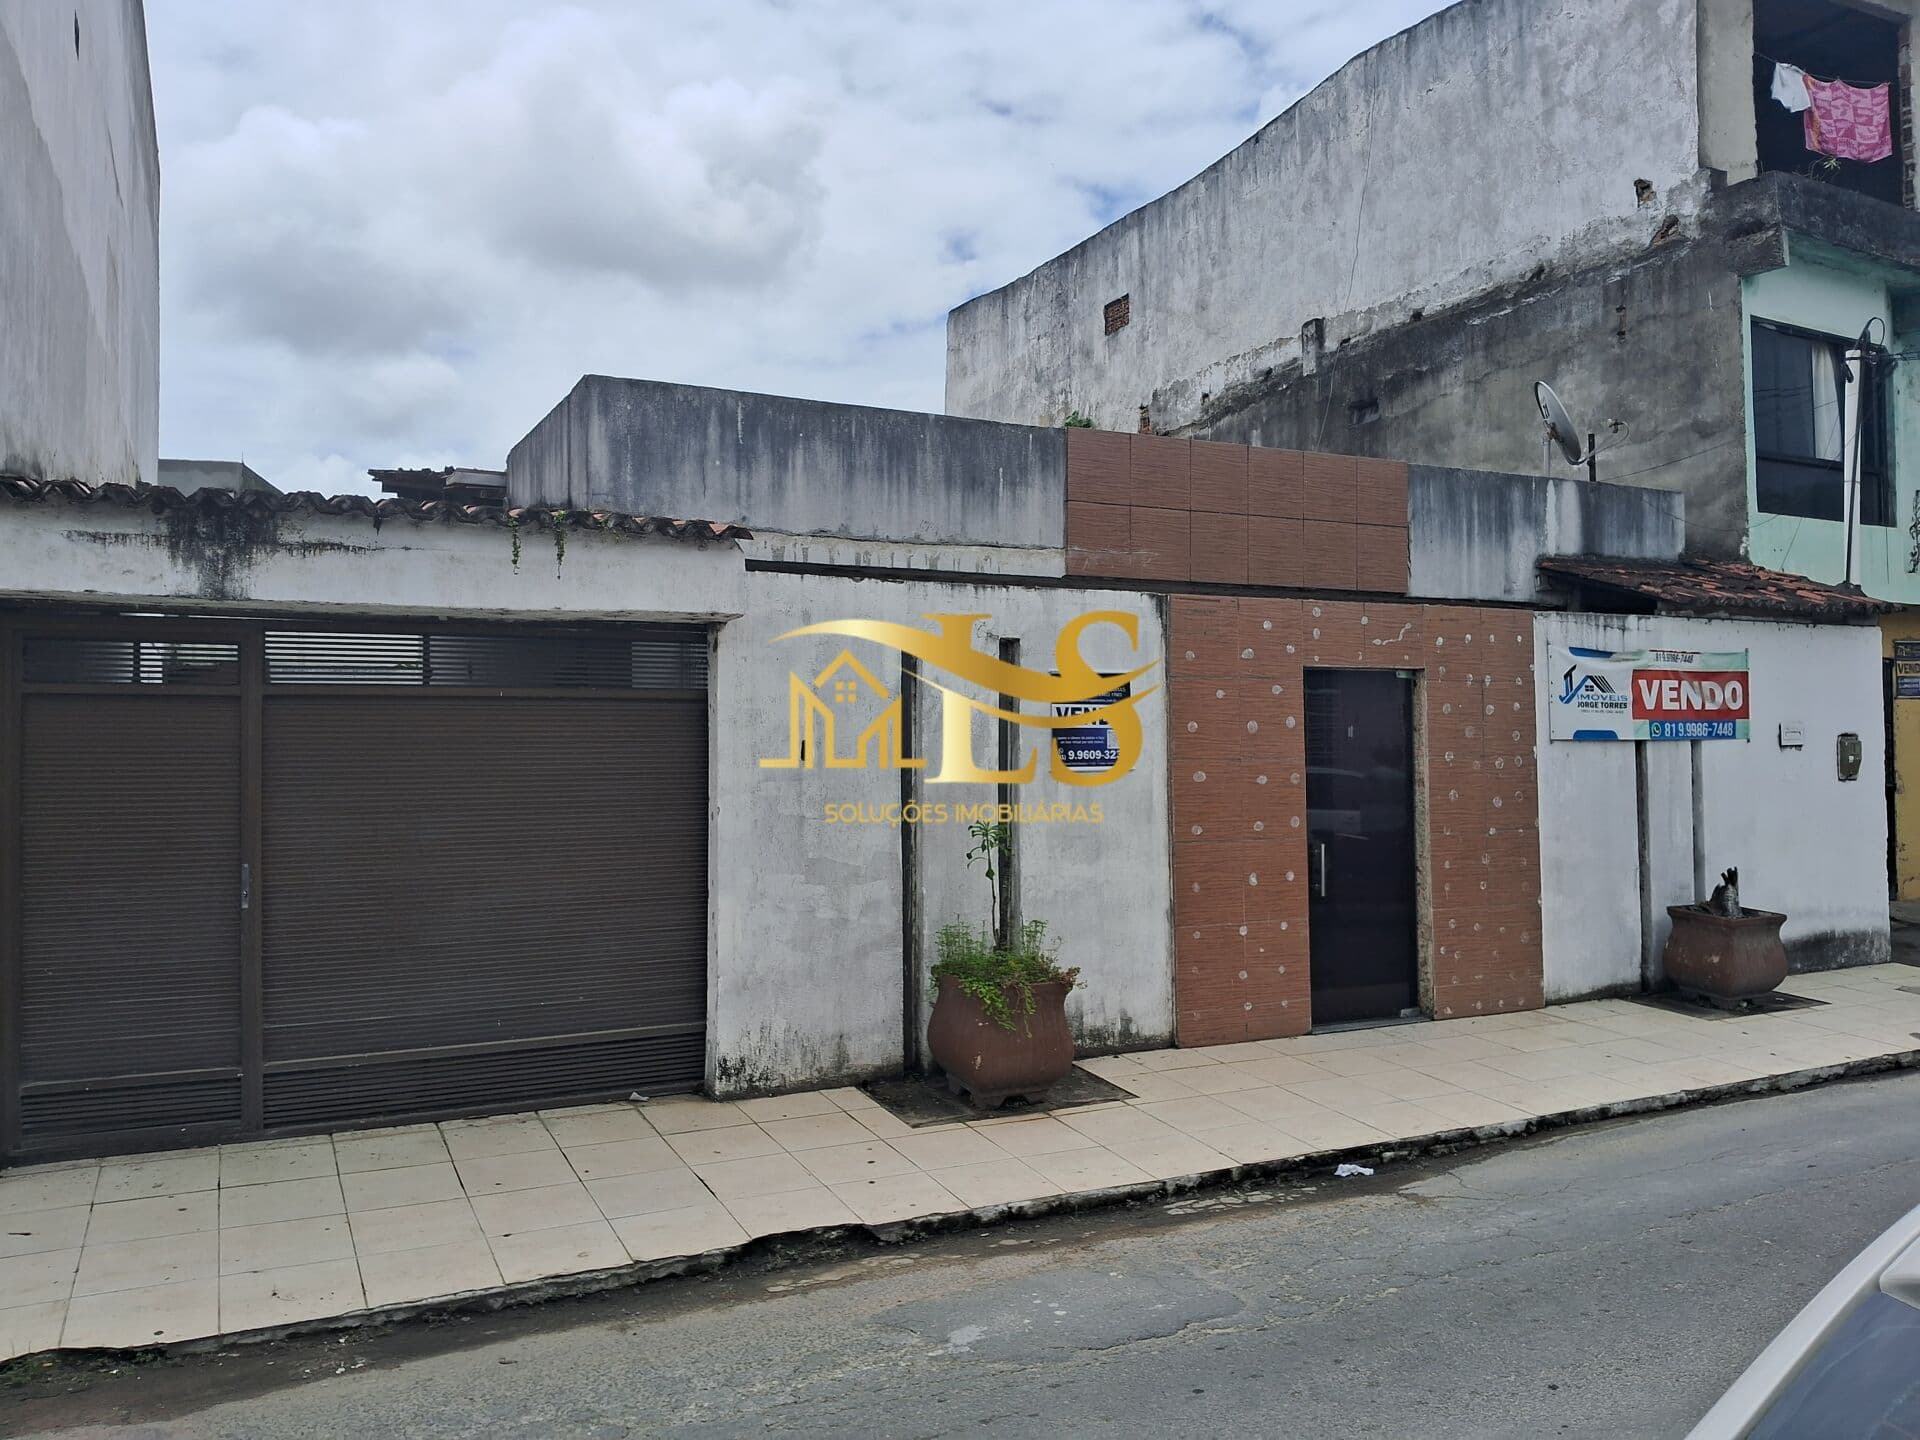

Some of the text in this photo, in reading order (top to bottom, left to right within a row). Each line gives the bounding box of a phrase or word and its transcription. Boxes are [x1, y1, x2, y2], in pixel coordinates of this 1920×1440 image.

[1638, 679, 1743, 710] VENDO
[1664, 722, 1733, 737] 81 9.9986-7448
